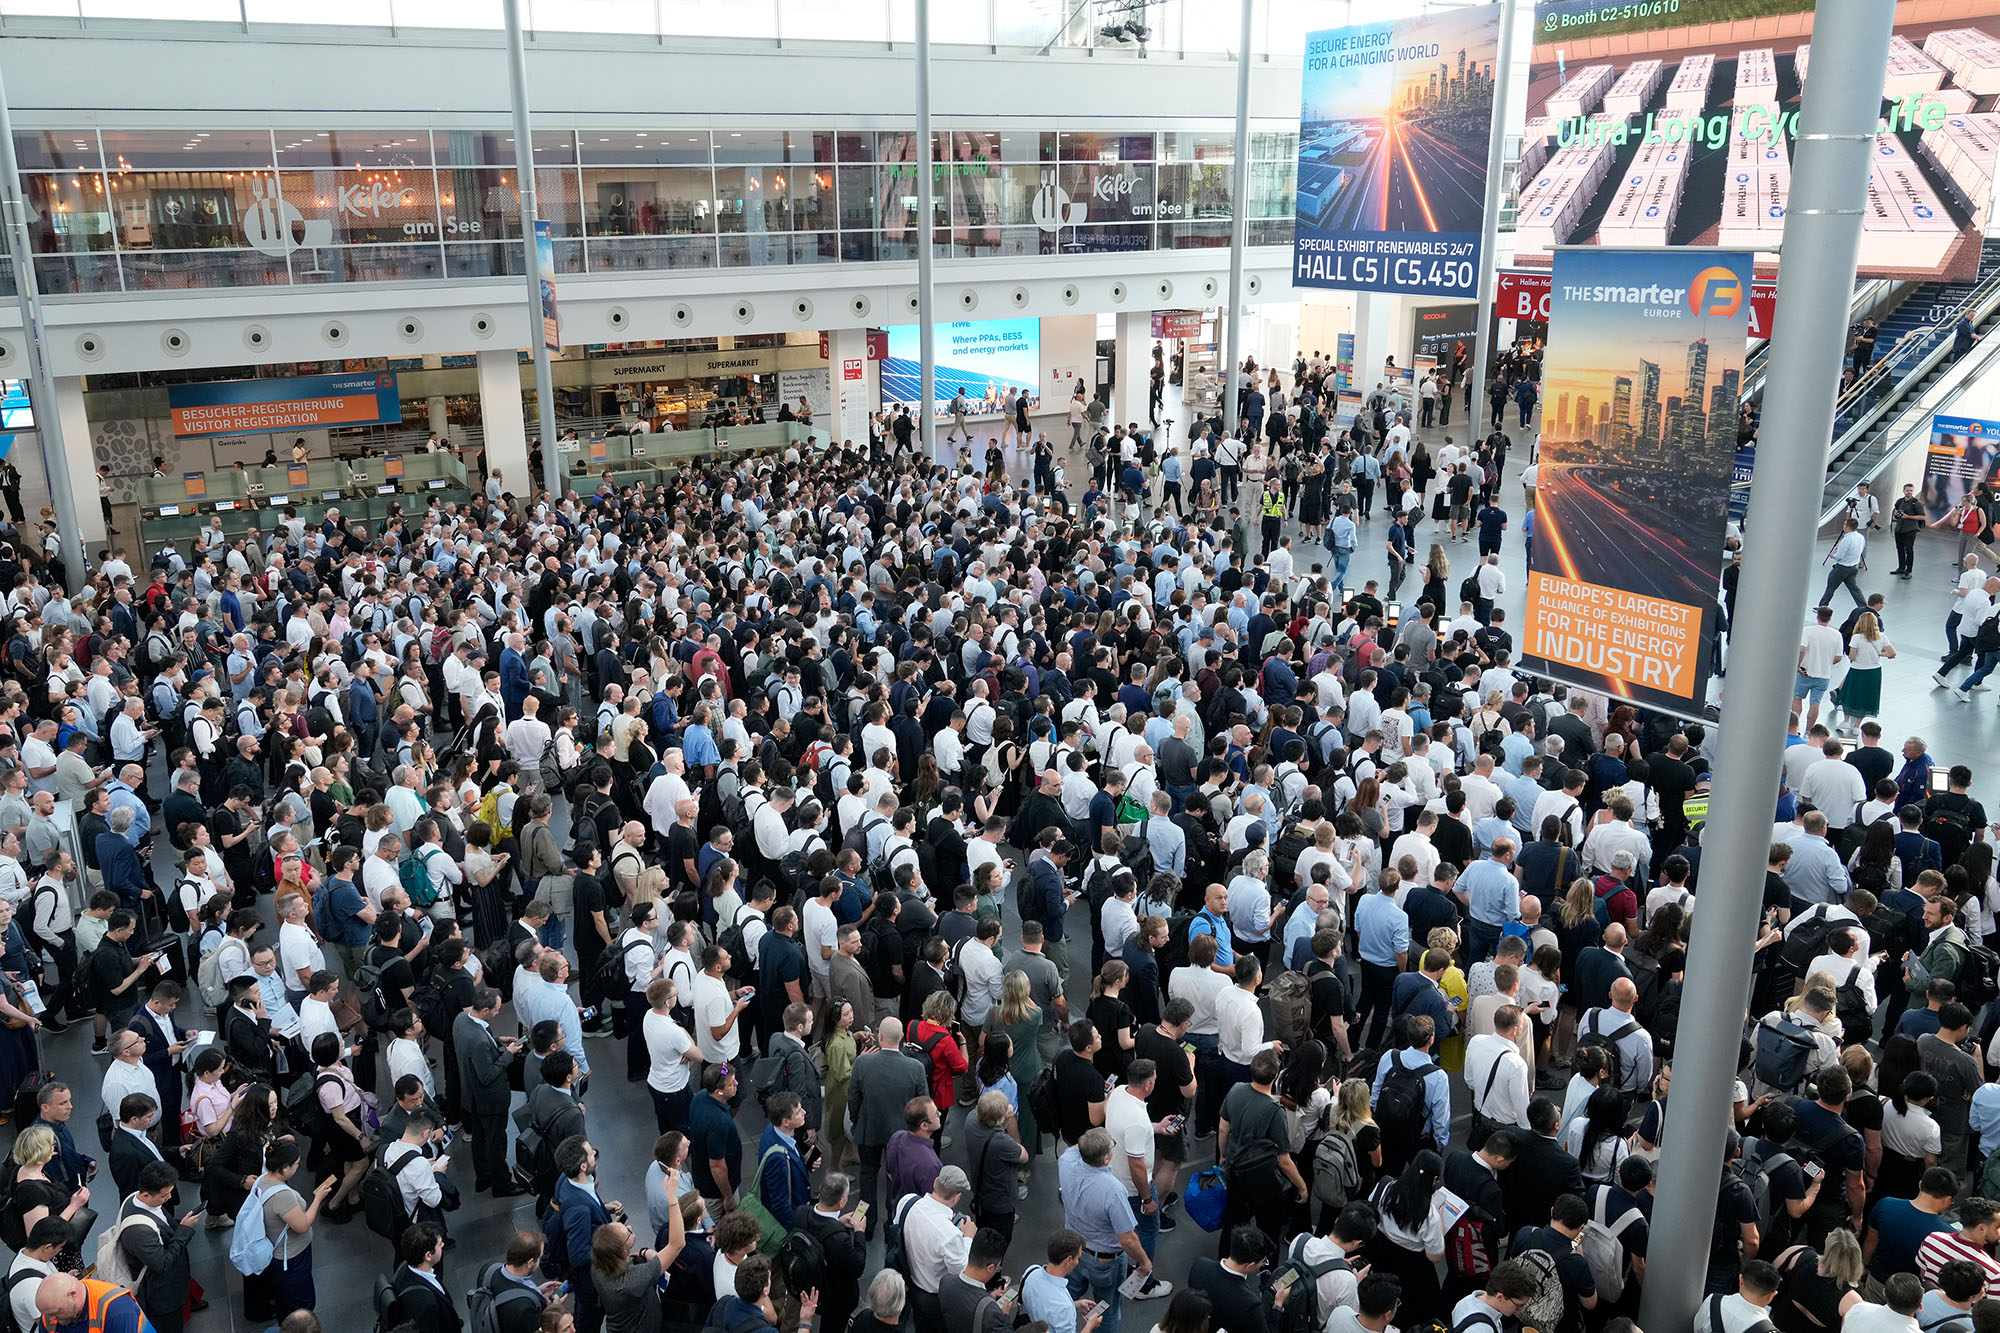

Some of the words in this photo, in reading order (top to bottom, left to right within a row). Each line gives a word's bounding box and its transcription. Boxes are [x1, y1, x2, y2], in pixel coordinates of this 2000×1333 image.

[1561, 12, 1597, 28] Booth
[1601, 0, 1679, 22] C2-510/610
[1309, 38, 1348, 55] SECURE
[1350, 31, 1393, 50] ENERGY
[1308, 57, 1328, 72] FOR
[1330, 56, 1338, 69] A
[1339, 49, 1395, 68] CHANGING
[1397, 43, 1440, 61] WORLD
[1557, 112, 1728, 150] Ultra-Long
[1742, 105, 1800, 148] Cyc
[1092, 174, 1143, 202] Käfer
[338, 182, 415, 218] Käfer
[1132, 204, 1153, 216] am
[1159, 200, 1182, 215] See
[403, 221, 435, 235] am
[446, 215, 481, 234] See
[1299, 238, 1336, 252] SPECIAL
[1338, 239, 1376, 253] EXHIBIT
[1377, 241, 1448, 256] RENEWABLES
[1450, 243, 1474, 257] 24/7
[1298, 255, 1347, 281] HALL
[1352, 256, 1379, 283] C5
[1394, 258, 1474, 289] C5.450
[1519, 278, 1539, 287] Hallen
[1643, 308, 1682, 319] EUROPE
[952, 335, 978, 344] Where
[979, 334, 1001, 343] PPAs,
[1002, 331, 1023, 341] BESS
[952, 346, 969, 355] and
[970, 345, 996, 355] energy
[997, 342, 1029, 353] markets
[613, 364, 667, 376] SUPERMARKT
[707, 358, 760, 370] SUPERMARKET
[182, 398, 345, 421] BESUCHER-REGISTRIERUNG
[183, 419, 232, 433] VISITOR
[234, 412, 319, 429] REGISTRATION
[1540, 577, 1613, 607] EUROPE'S
[1618, 594, 1690, 624] LARGEST
[1538, 595, 1589, 617] ALLIANCE
[1592, 607, 1609, 620] OF
[1610, 611, 1687, 640] EXHIBITIONS
[1537, 609, 1571, 632] FOR
[1574, 618, 1607, 641] THE
[1612, 627, 1686, 661] ENERGY
[1536, 628, 1683, 689] INDUSTRY
[1685, 805, 1707, 813] SECURIT
